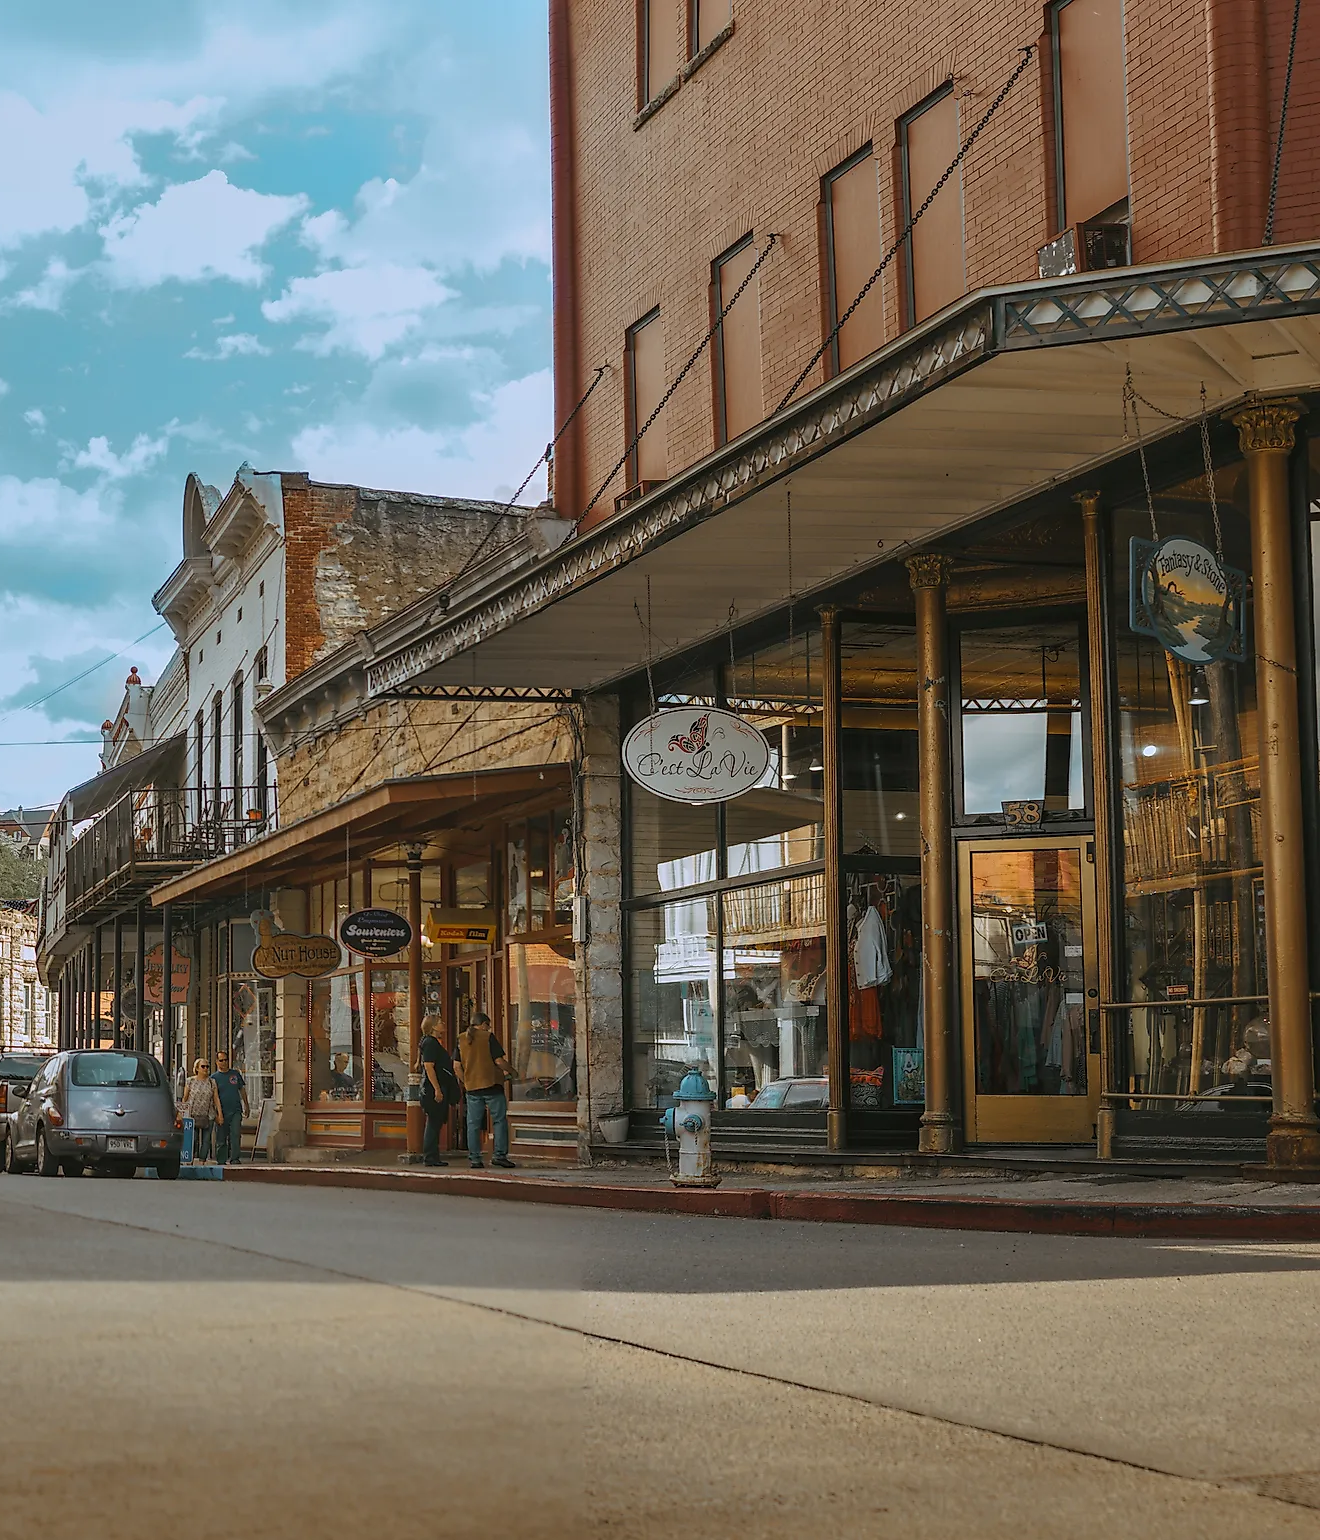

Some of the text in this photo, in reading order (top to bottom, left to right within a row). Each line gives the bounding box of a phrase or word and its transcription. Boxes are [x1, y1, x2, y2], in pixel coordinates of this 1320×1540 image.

[1158, 549, 1196, 577] Fantasy
[1201, 558, 1226, 594] Stone
[637, 750, 759, 780] C'est La Vie
[1006, 802, 1041, 825] 58
[469, 930, 486, 938] film
[1015, 926, 1047, 942] OPEN
[299, 945, 338, 963] HOUSE
